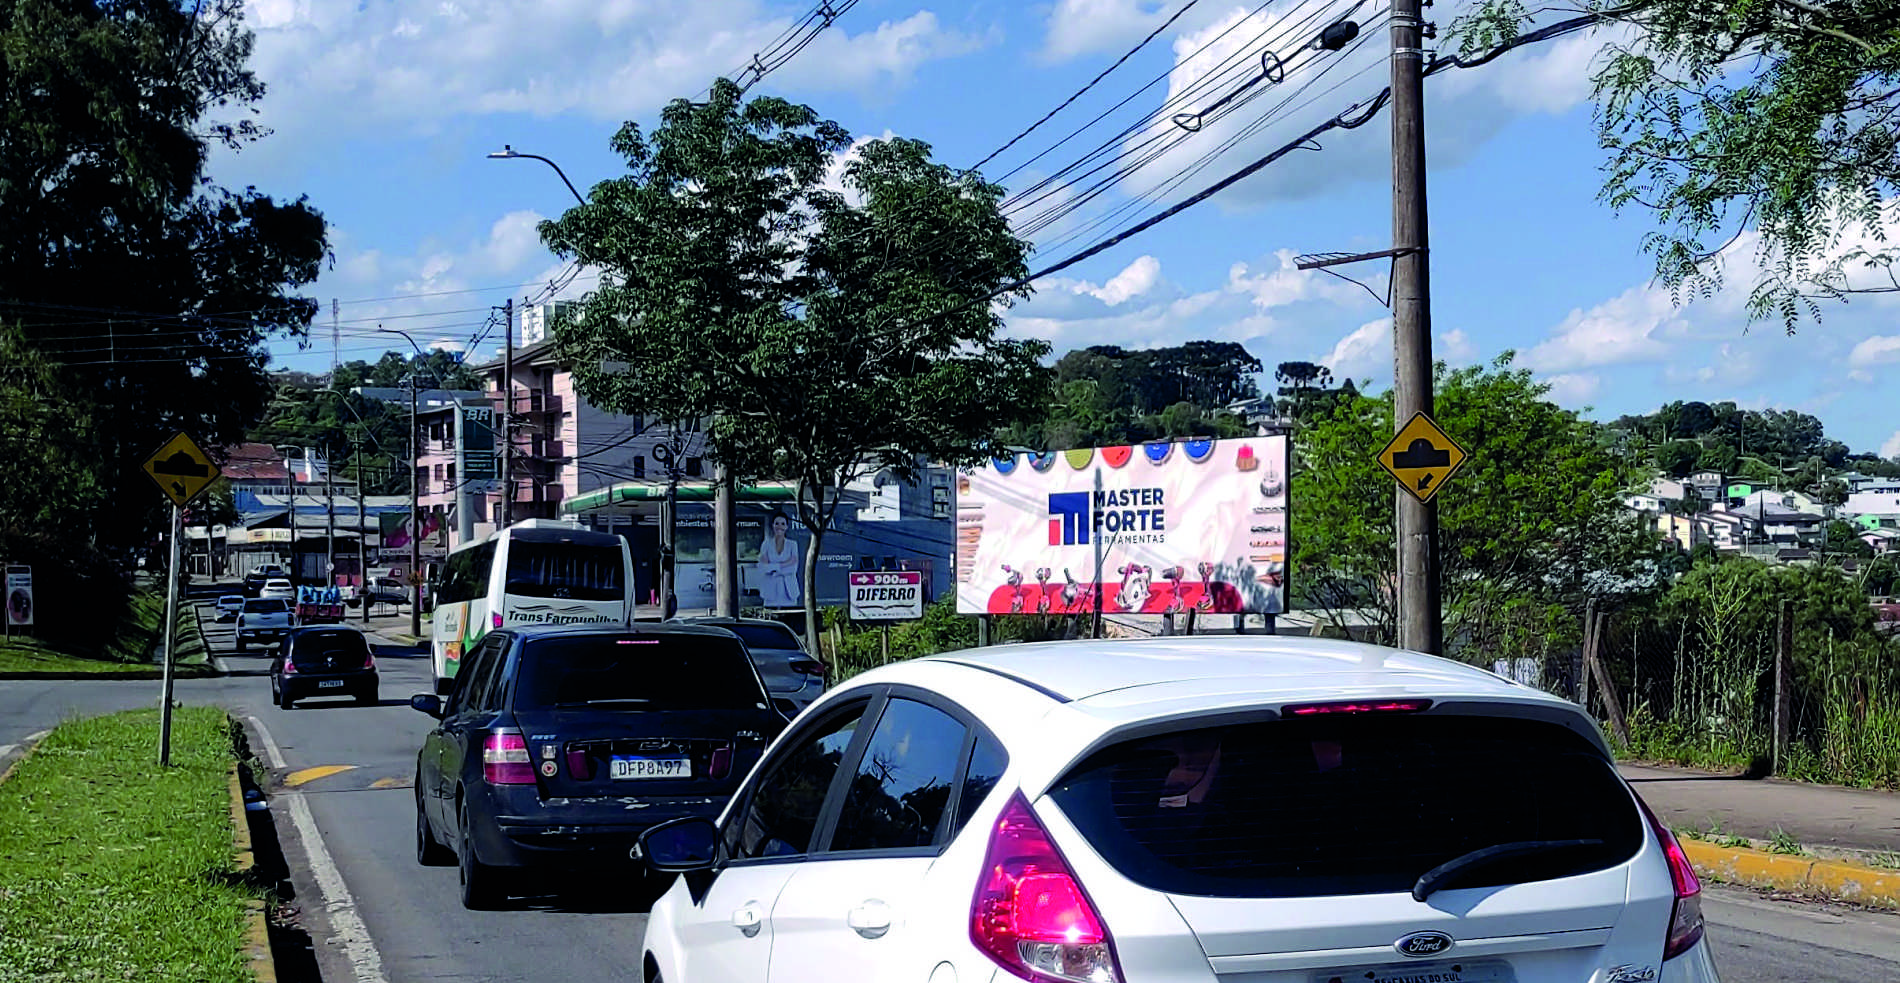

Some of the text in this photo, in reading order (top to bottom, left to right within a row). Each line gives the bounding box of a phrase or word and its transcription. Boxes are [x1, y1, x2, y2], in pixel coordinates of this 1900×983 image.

[466, 409, 490, 421] BR
[646, 486, 668, 497] BR
[1093, 488, 1164, 508] MASTER
[1093, 508, 1165, 533] FORTE
[855, 587, 916, 602] DIFERRO
[508, 610, 544, 623] Trans
[618, 761, 682, 776] DFP8A97
[1410, 936, 1442, 952] Ford
[1442, 972, 1461, 982] SUL
